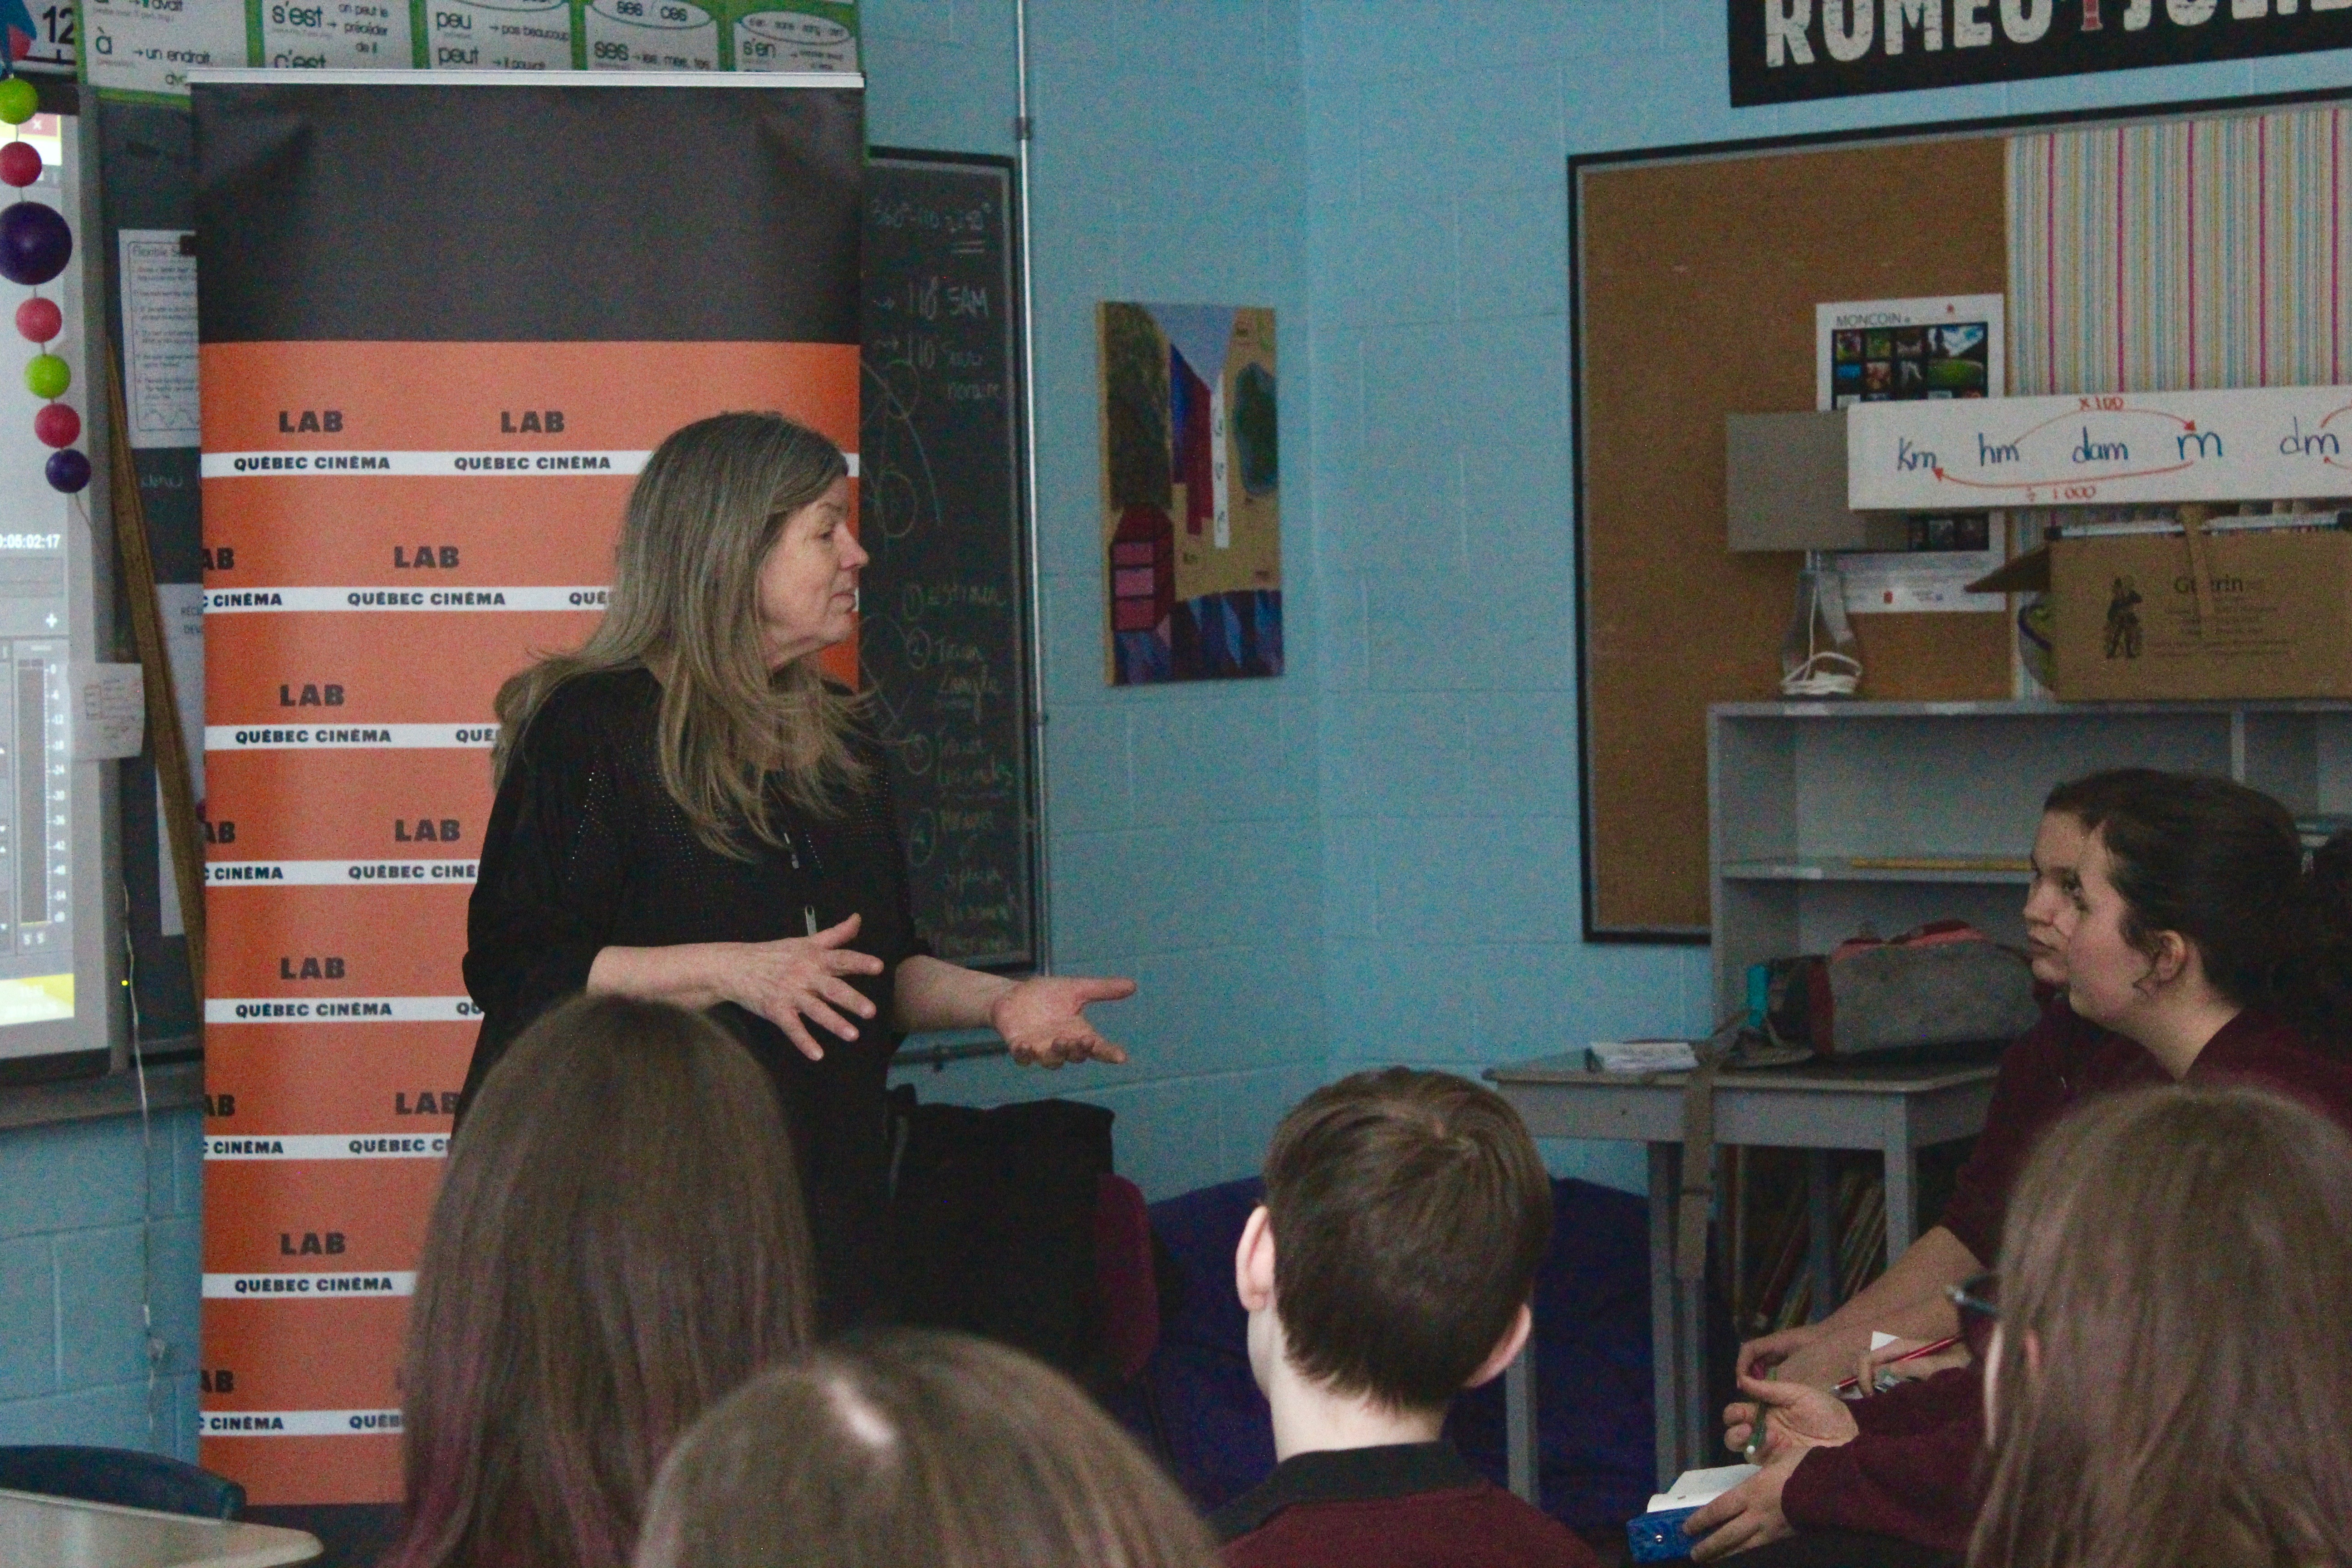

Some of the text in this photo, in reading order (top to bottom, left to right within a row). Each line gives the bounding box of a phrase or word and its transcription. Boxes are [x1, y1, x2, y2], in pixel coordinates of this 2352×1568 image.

[272, 1, 323, 27] s'est
[436, 11, 471, 31] peu
[95, 26, 113, 54] à
[438, 46, 479, 66] peut
[594, 41, 629, 60] ses
[279, 411, 343, 433] LAB
[501, 412, 564, 433] LAB
[1979, 432, 2019, 466] hm
[2073, 426, 2128, 463] dam
[2177, 430, 2223, 460] m
[2280, 416, 2340, 455] dm
[234, 456, 390, 472] QUÉBEC CINÉMA
[455, 455, 611, 470] QUÉBEC CINÉMA
[203, 548, 234, 570] AB
[395, 546, 459, 568] LAB
[2174, 574, 2244, 594] Grin
[213, 593, 282, 607] CINÉMA
[348, 591, 505, 606] QUÉBEC CINÉMA
[569, 590, 608, 606] QUÉ
[280, 685, 344, 706] LAB
[236, 729, 391, 744] QUÉBEC CINÉMA
[456, 729, 496, 743] QUÉ
[205, 822, 235, 844] AB
[396, 819, 460, 841] LAB
[215, 866, 283, 880] CINÉMA
[349, 864, 477, 880] QUÉBEC CINÉ
[281, 958, 345, 980] LAB
[236, 1002, 392, 1018] QUÉBEC CINÉMA
[204, 1094, 235, 1117] AB
[214, 1140, 284, 1154] CINÉMA
[349, 1139, 425, 1154] QUÉBEC
[281, 1232, 345, 1255] LAB
[235, 1277, 392, 1294] QUÉBEC CINÉMA
[200, 1370, 234, 1393] AB
[211, 1416, 284, 1430] CINÉMA
[349, 1415, 400, 1429] QUÉB
